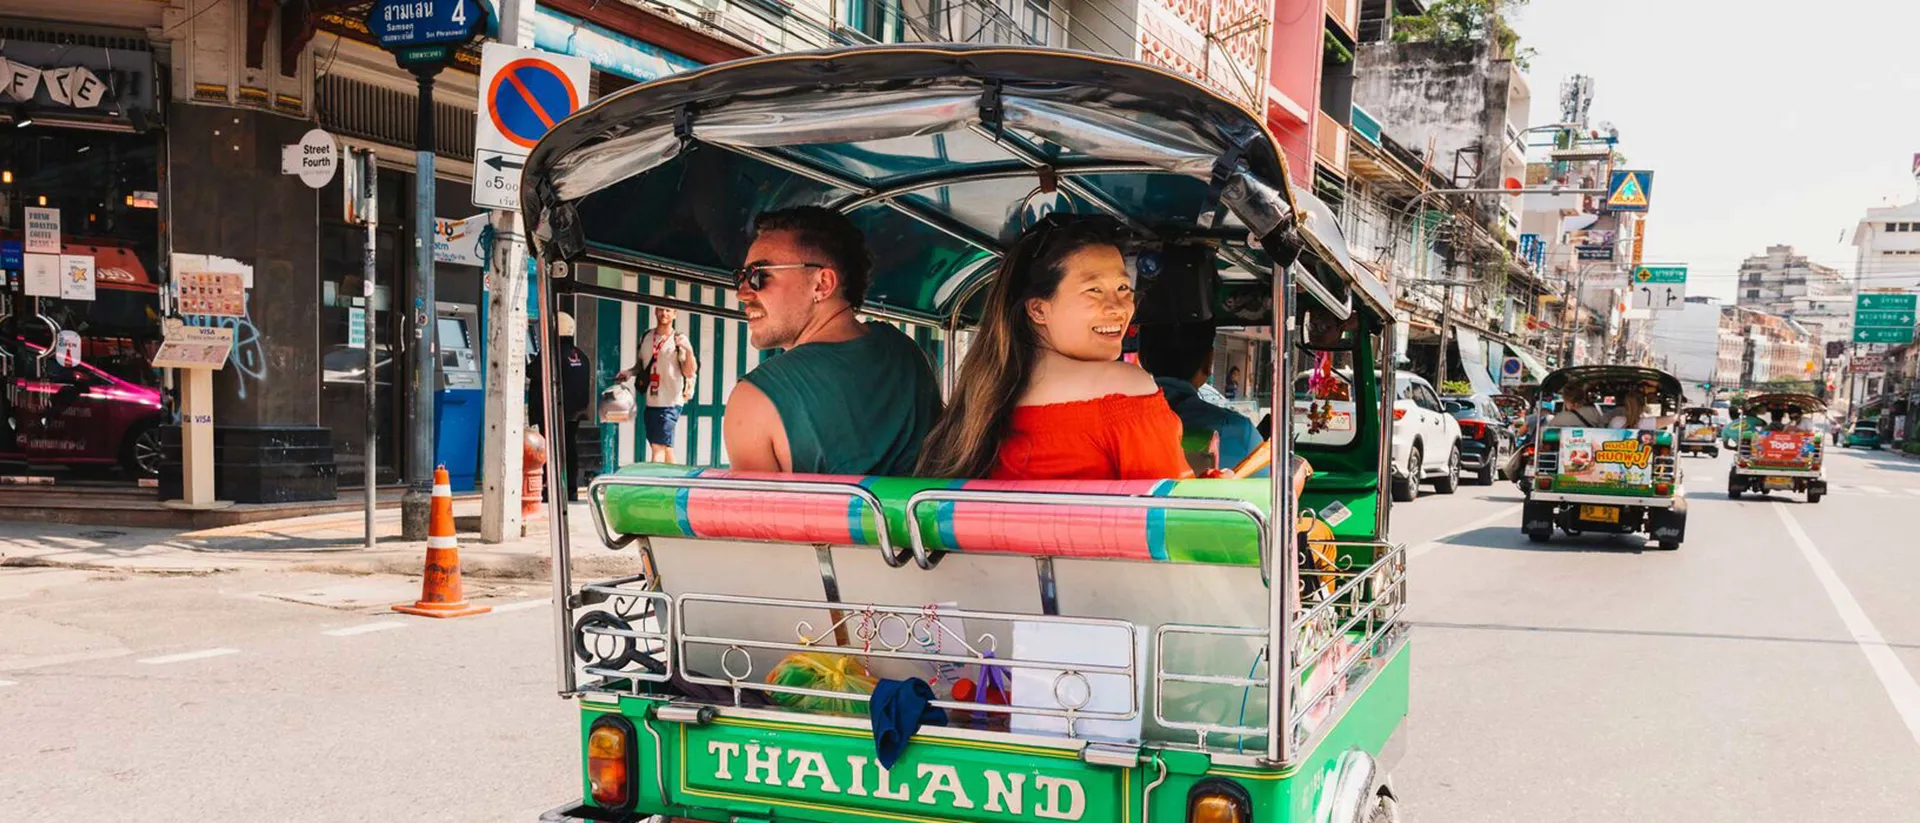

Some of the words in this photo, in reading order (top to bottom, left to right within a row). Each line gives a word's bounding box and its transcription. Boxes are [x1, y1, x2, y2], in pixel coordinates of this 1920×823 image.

[384, 2, 433, 21] สามเสน
[451, 0, 467, 26] 4
[386, 23, 414, 33] Samsen
[303, 144, 330, 155] Street
[302, 157, 331, 168] Fourth
[195, 415, 211, 423] VISA
[1769, 441, 1796, 450] Tops
[707, 740, 1087, 822] THAILAND
